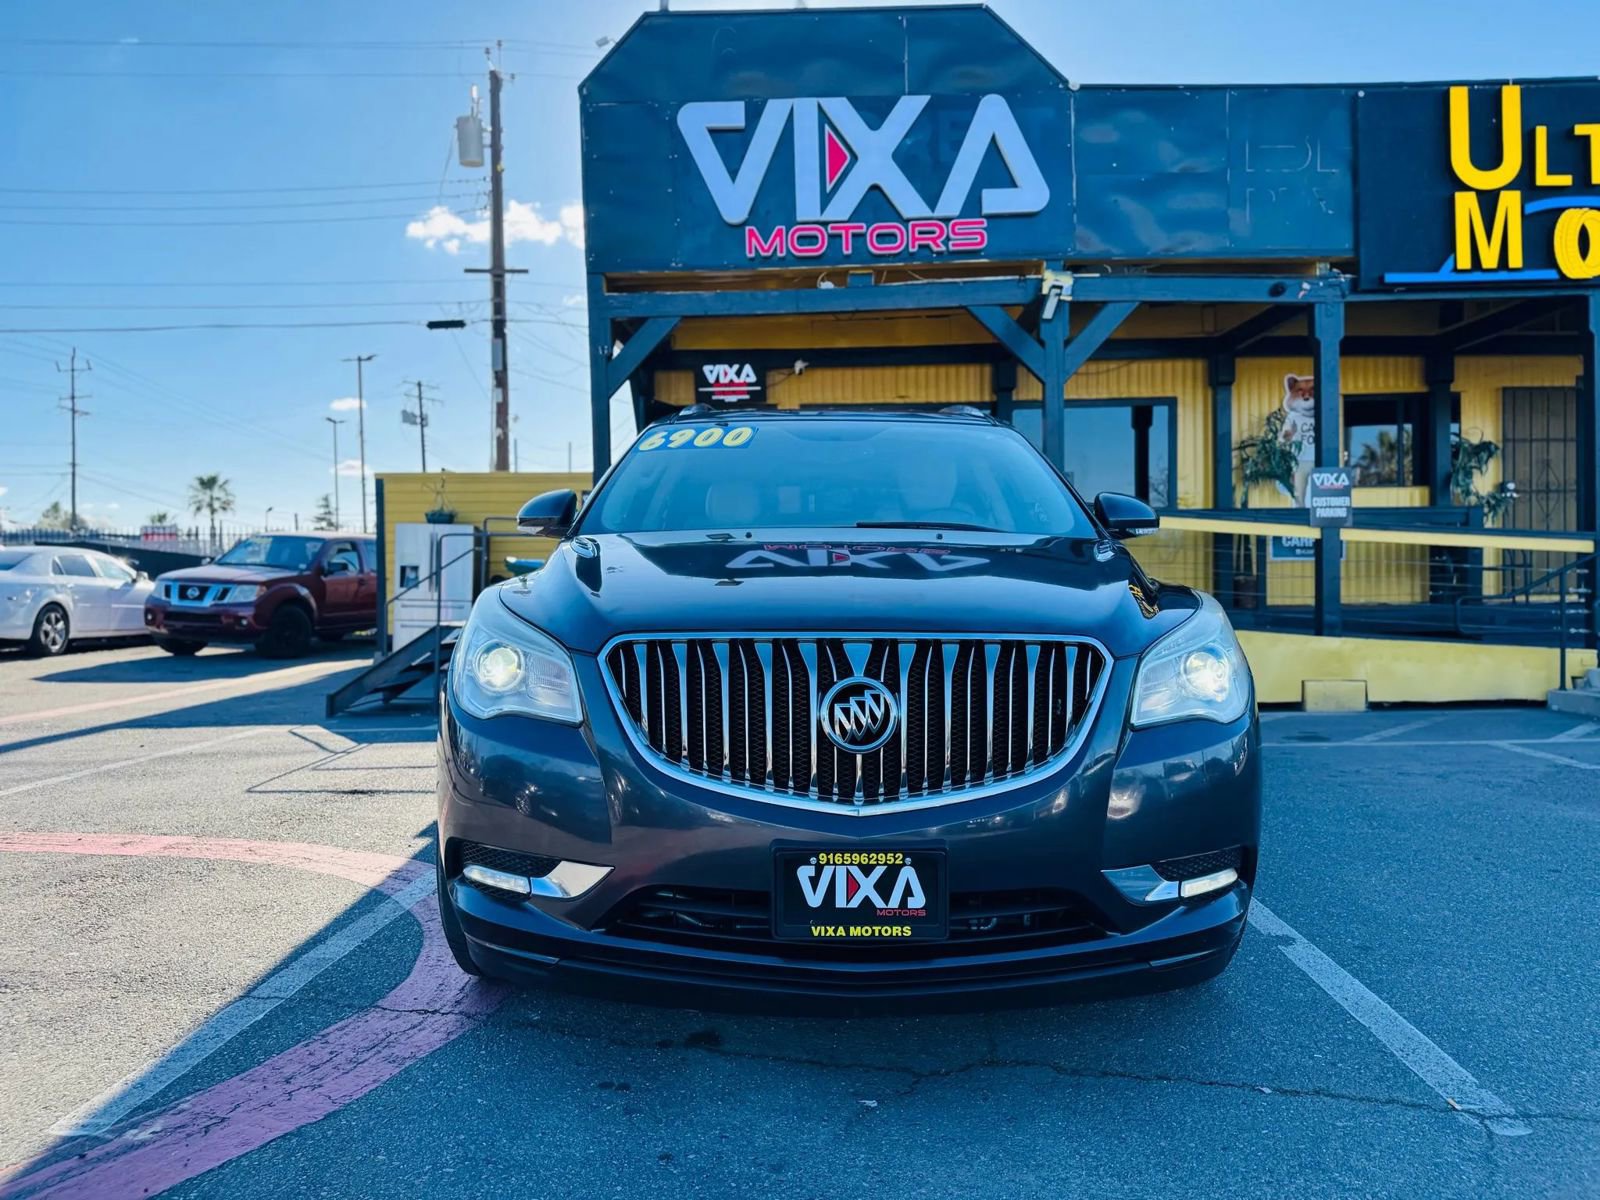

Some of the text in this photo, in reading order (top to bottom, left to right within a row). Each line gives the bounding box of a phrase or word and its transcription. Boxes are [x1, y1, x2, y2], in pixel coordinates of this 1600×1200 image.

[677, 94, 1051, 225] VIXA
[746, 218, 988, 258] MOTORS
[702, 363, 757, 384] VIXA
[638, 427, 752, 451] 6900
[1312, 472, 1349, 486] VIXA
[1312, 496, 1350, 507] CUSTOMER
[1316, 507, 1347, 517] PARKING
[818, 853, 904, 865] 9165962952
[797, 865, 926, 908] VIXA
[811, 926, 912, 937] VIXA MOTORS
